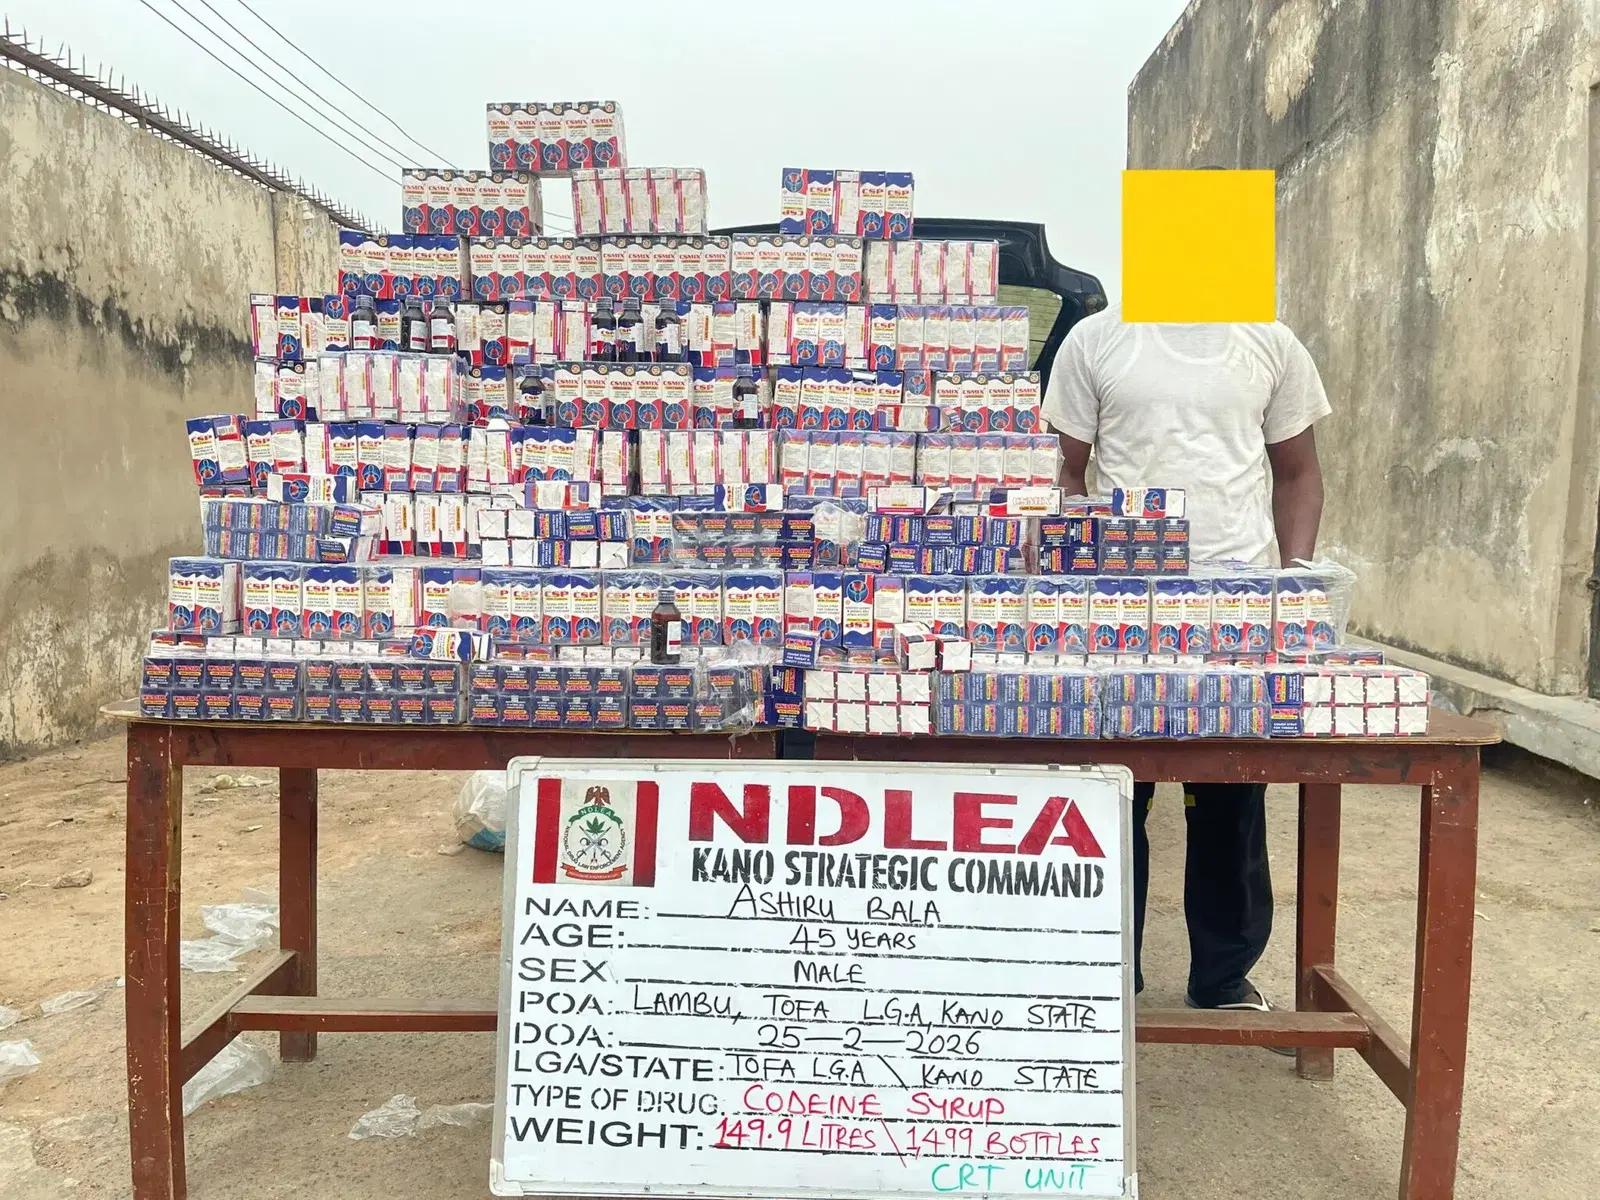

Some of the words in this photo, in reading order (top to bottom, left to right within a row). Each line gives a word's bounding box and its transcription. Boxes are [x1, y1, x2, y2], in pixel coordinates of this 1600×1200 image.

[688, 782, 1106, 858] NDLEA
[692, 847, 774, 884] KANO
[785, 850, 938, 892] STRATEGIC
[948, 857, 1105, 898] COMMAND
[525, 897, 650, 919] NAME:
[727, 884, 834, 921] ASHIRU
[867, 896, 942, 923] BALA
[520, 922, 624, 948] AGE:
[789, 924, 836, 951] 45
[846, 927, 917, 950] YEARS
[794, 960, 866, 984] MALE
[519, 990, 614, 1015] POA:
[634, 984, 743, 1025] LAMBU,
[764, 994, 828, 1022] TOFA
[941, 999, 1004, 1026] KANO
[1028, 1003, 1096, 1029] STATE
[514, 1022, 614, 1048] DOA:
[514, 1050, 724, 1081] LGA/STATE:
[726, 1052, 796, 1080] TOFA
[813, 1059, 866, 1083] L.G.A
[922, 1064, 983, 1088] KANO
[1015, 1066, 1099, 1090] STATE
[510, 1084, 582, 1109] TYPE
[591, 1088, 628, 1111] OF
[744, 1084, 882, 1116] CODEINE
[907, 1092, 1005, 1126] SYRUP
[510, 1116, 703, 1150] WEIGHT:
[715, 1117, 792, 1149] 149.9
[802, 1120, 876, 1149] LITRES
[984, 1131, 1100, 1156] BOTTLES
[931, 1163, 1005, 1193] CRT
[1025, 1164, 1096, 1190] UNIT
